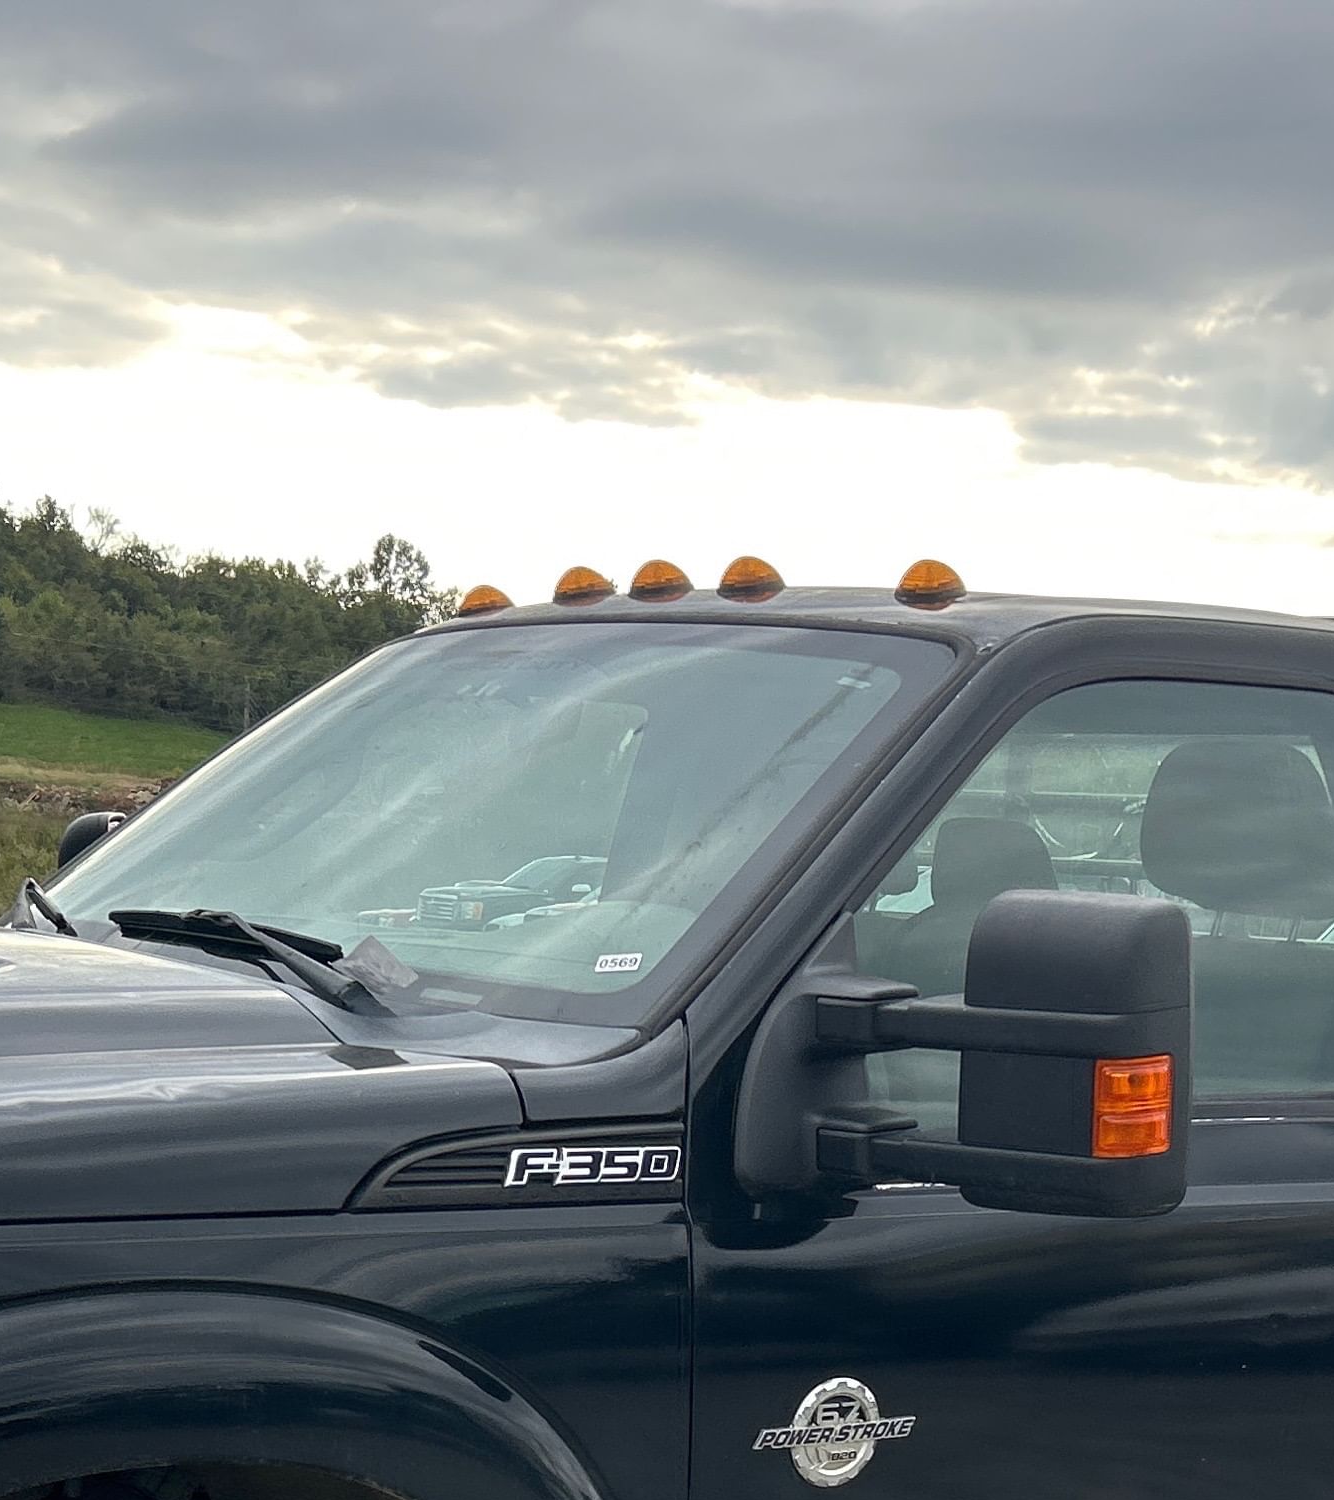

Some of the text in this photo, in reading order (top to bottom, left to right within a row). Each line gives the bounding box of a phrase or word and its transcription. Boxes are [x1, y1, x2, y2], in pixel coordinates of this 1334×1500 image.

[599, 957, 638, 969] 0569
[504, 1146, 682, 1188] F-350
[817, 1401, 865, 1424] 6.7
[755, 1417, 915, 1449] POWER STROKE
